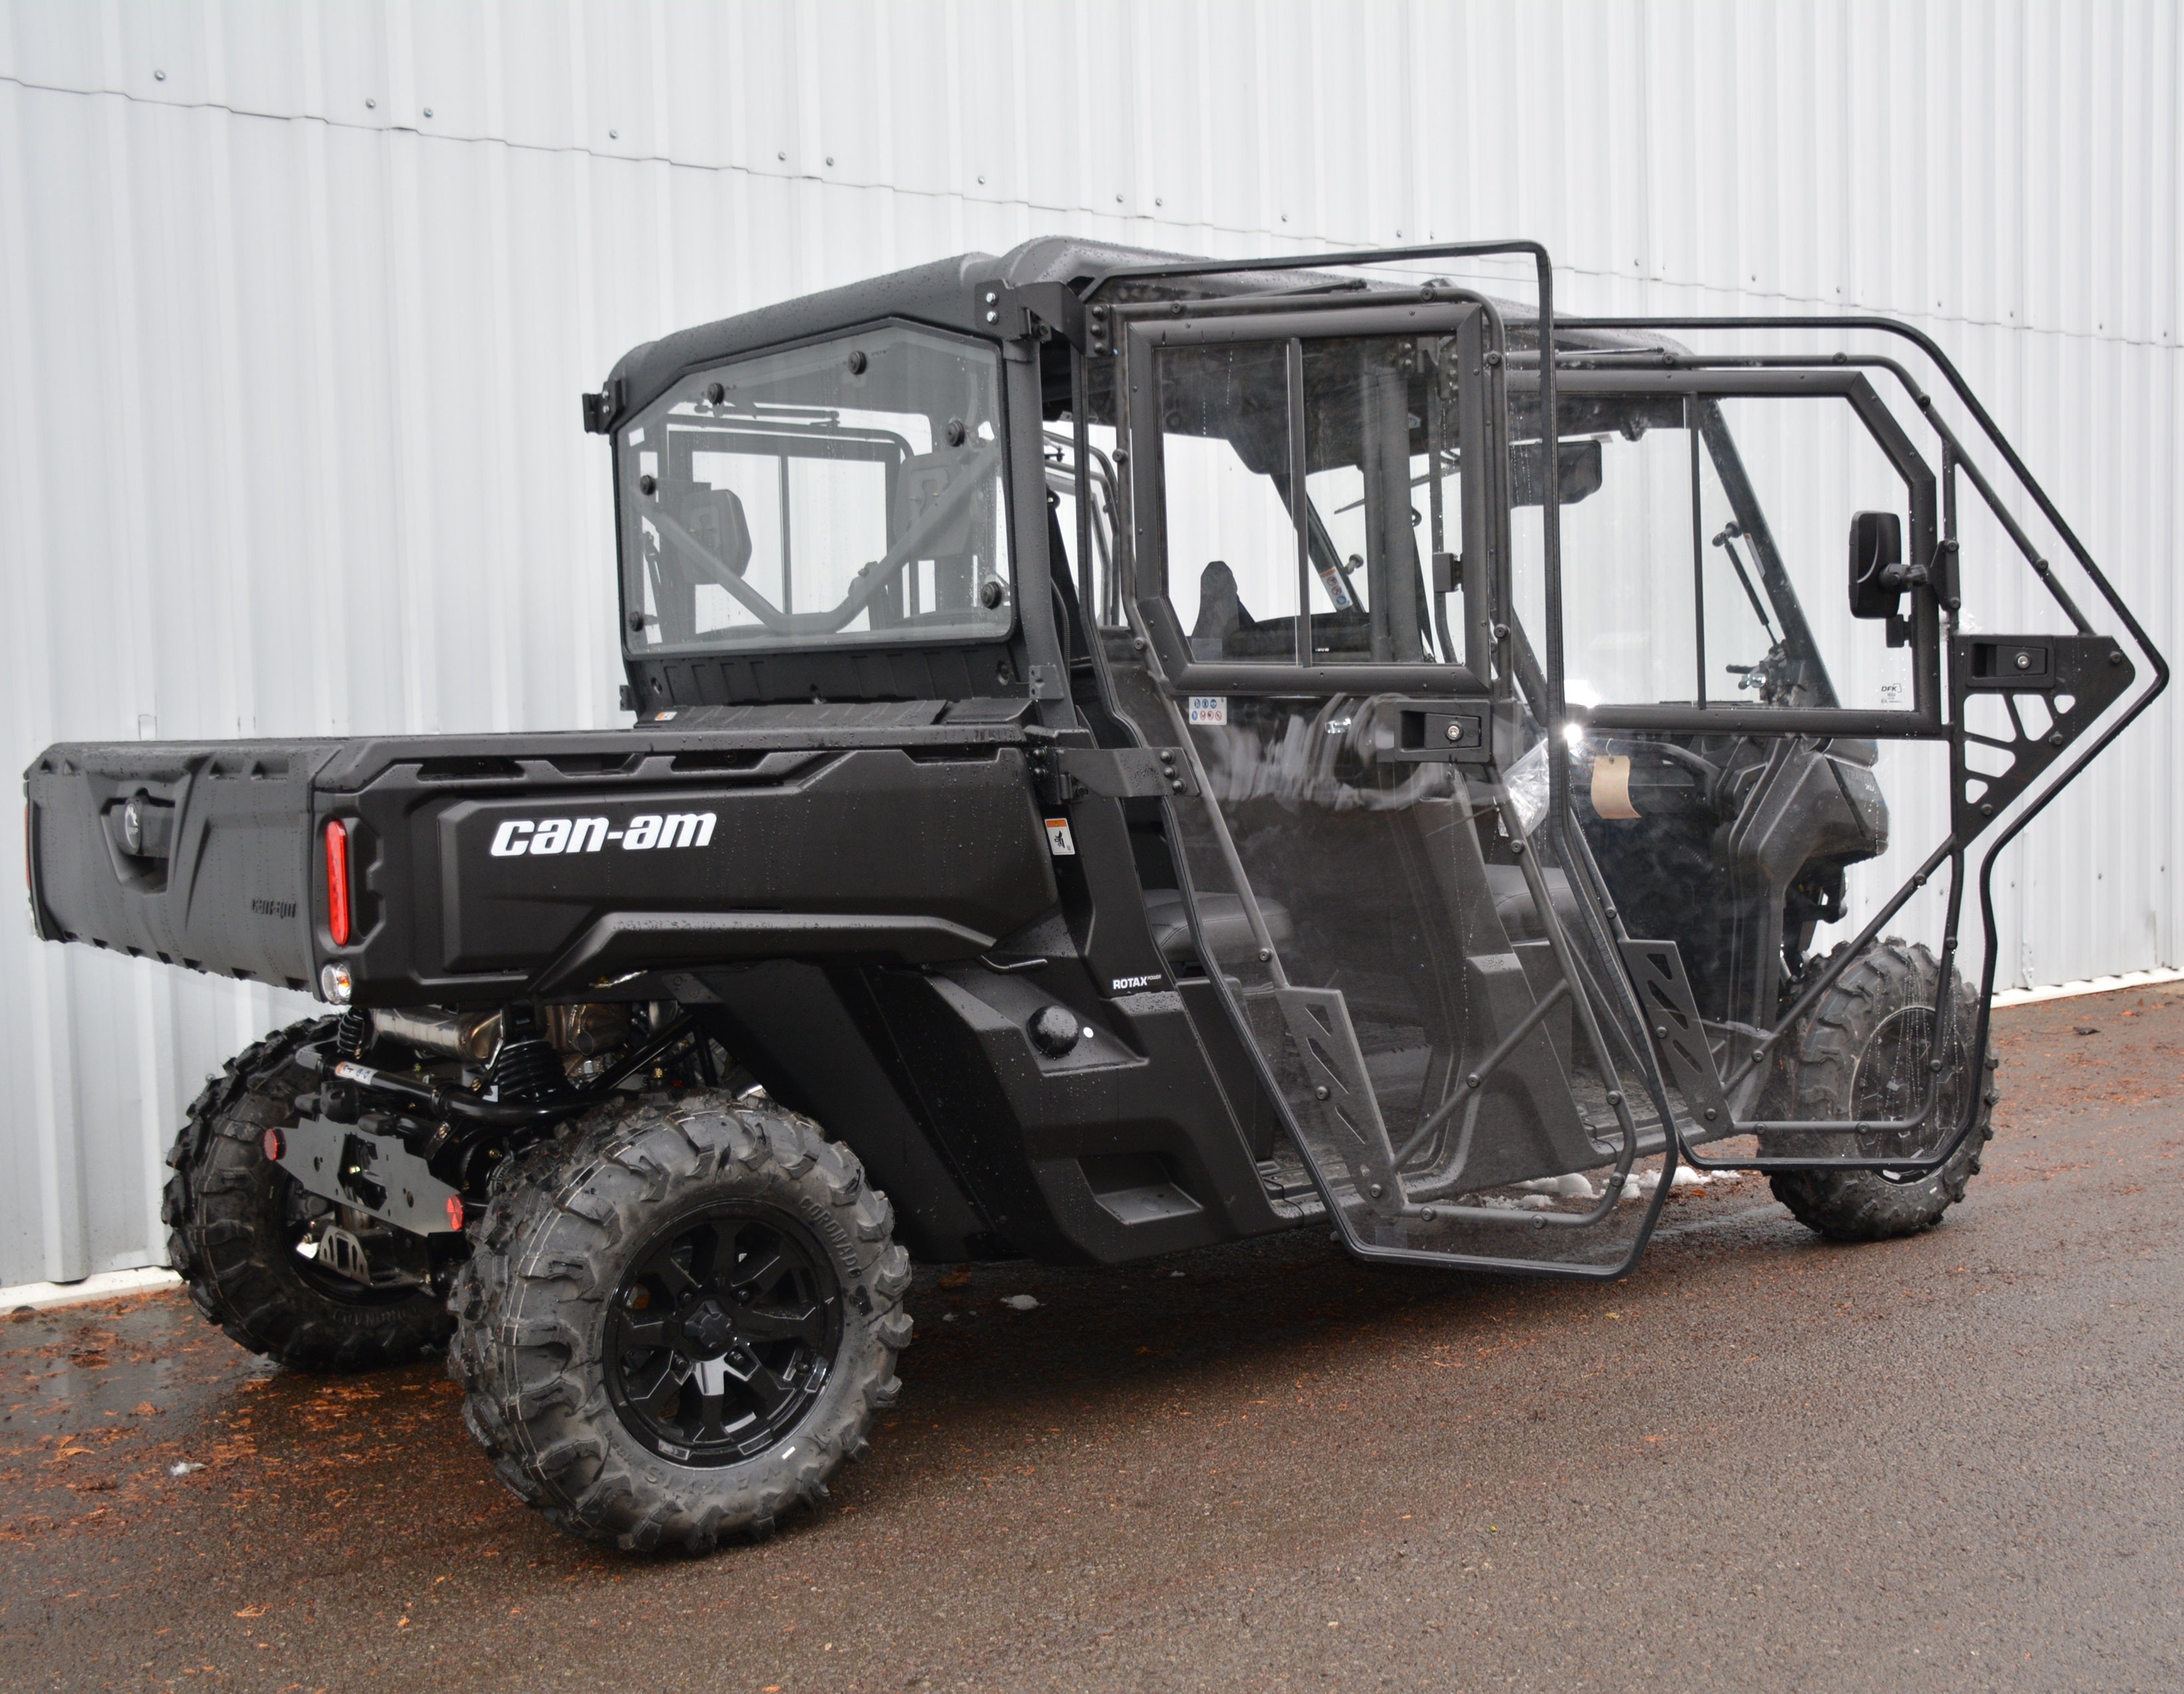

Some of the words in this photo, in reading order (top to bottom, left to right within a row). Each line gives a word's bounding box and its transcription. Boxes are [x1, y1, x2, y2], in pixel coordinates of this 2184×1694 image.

[489, 812, 717, 857] can-am
[1113, 977, 1148, 989] ROTAX
[797, 1195, 863, 1278] CORONADO
